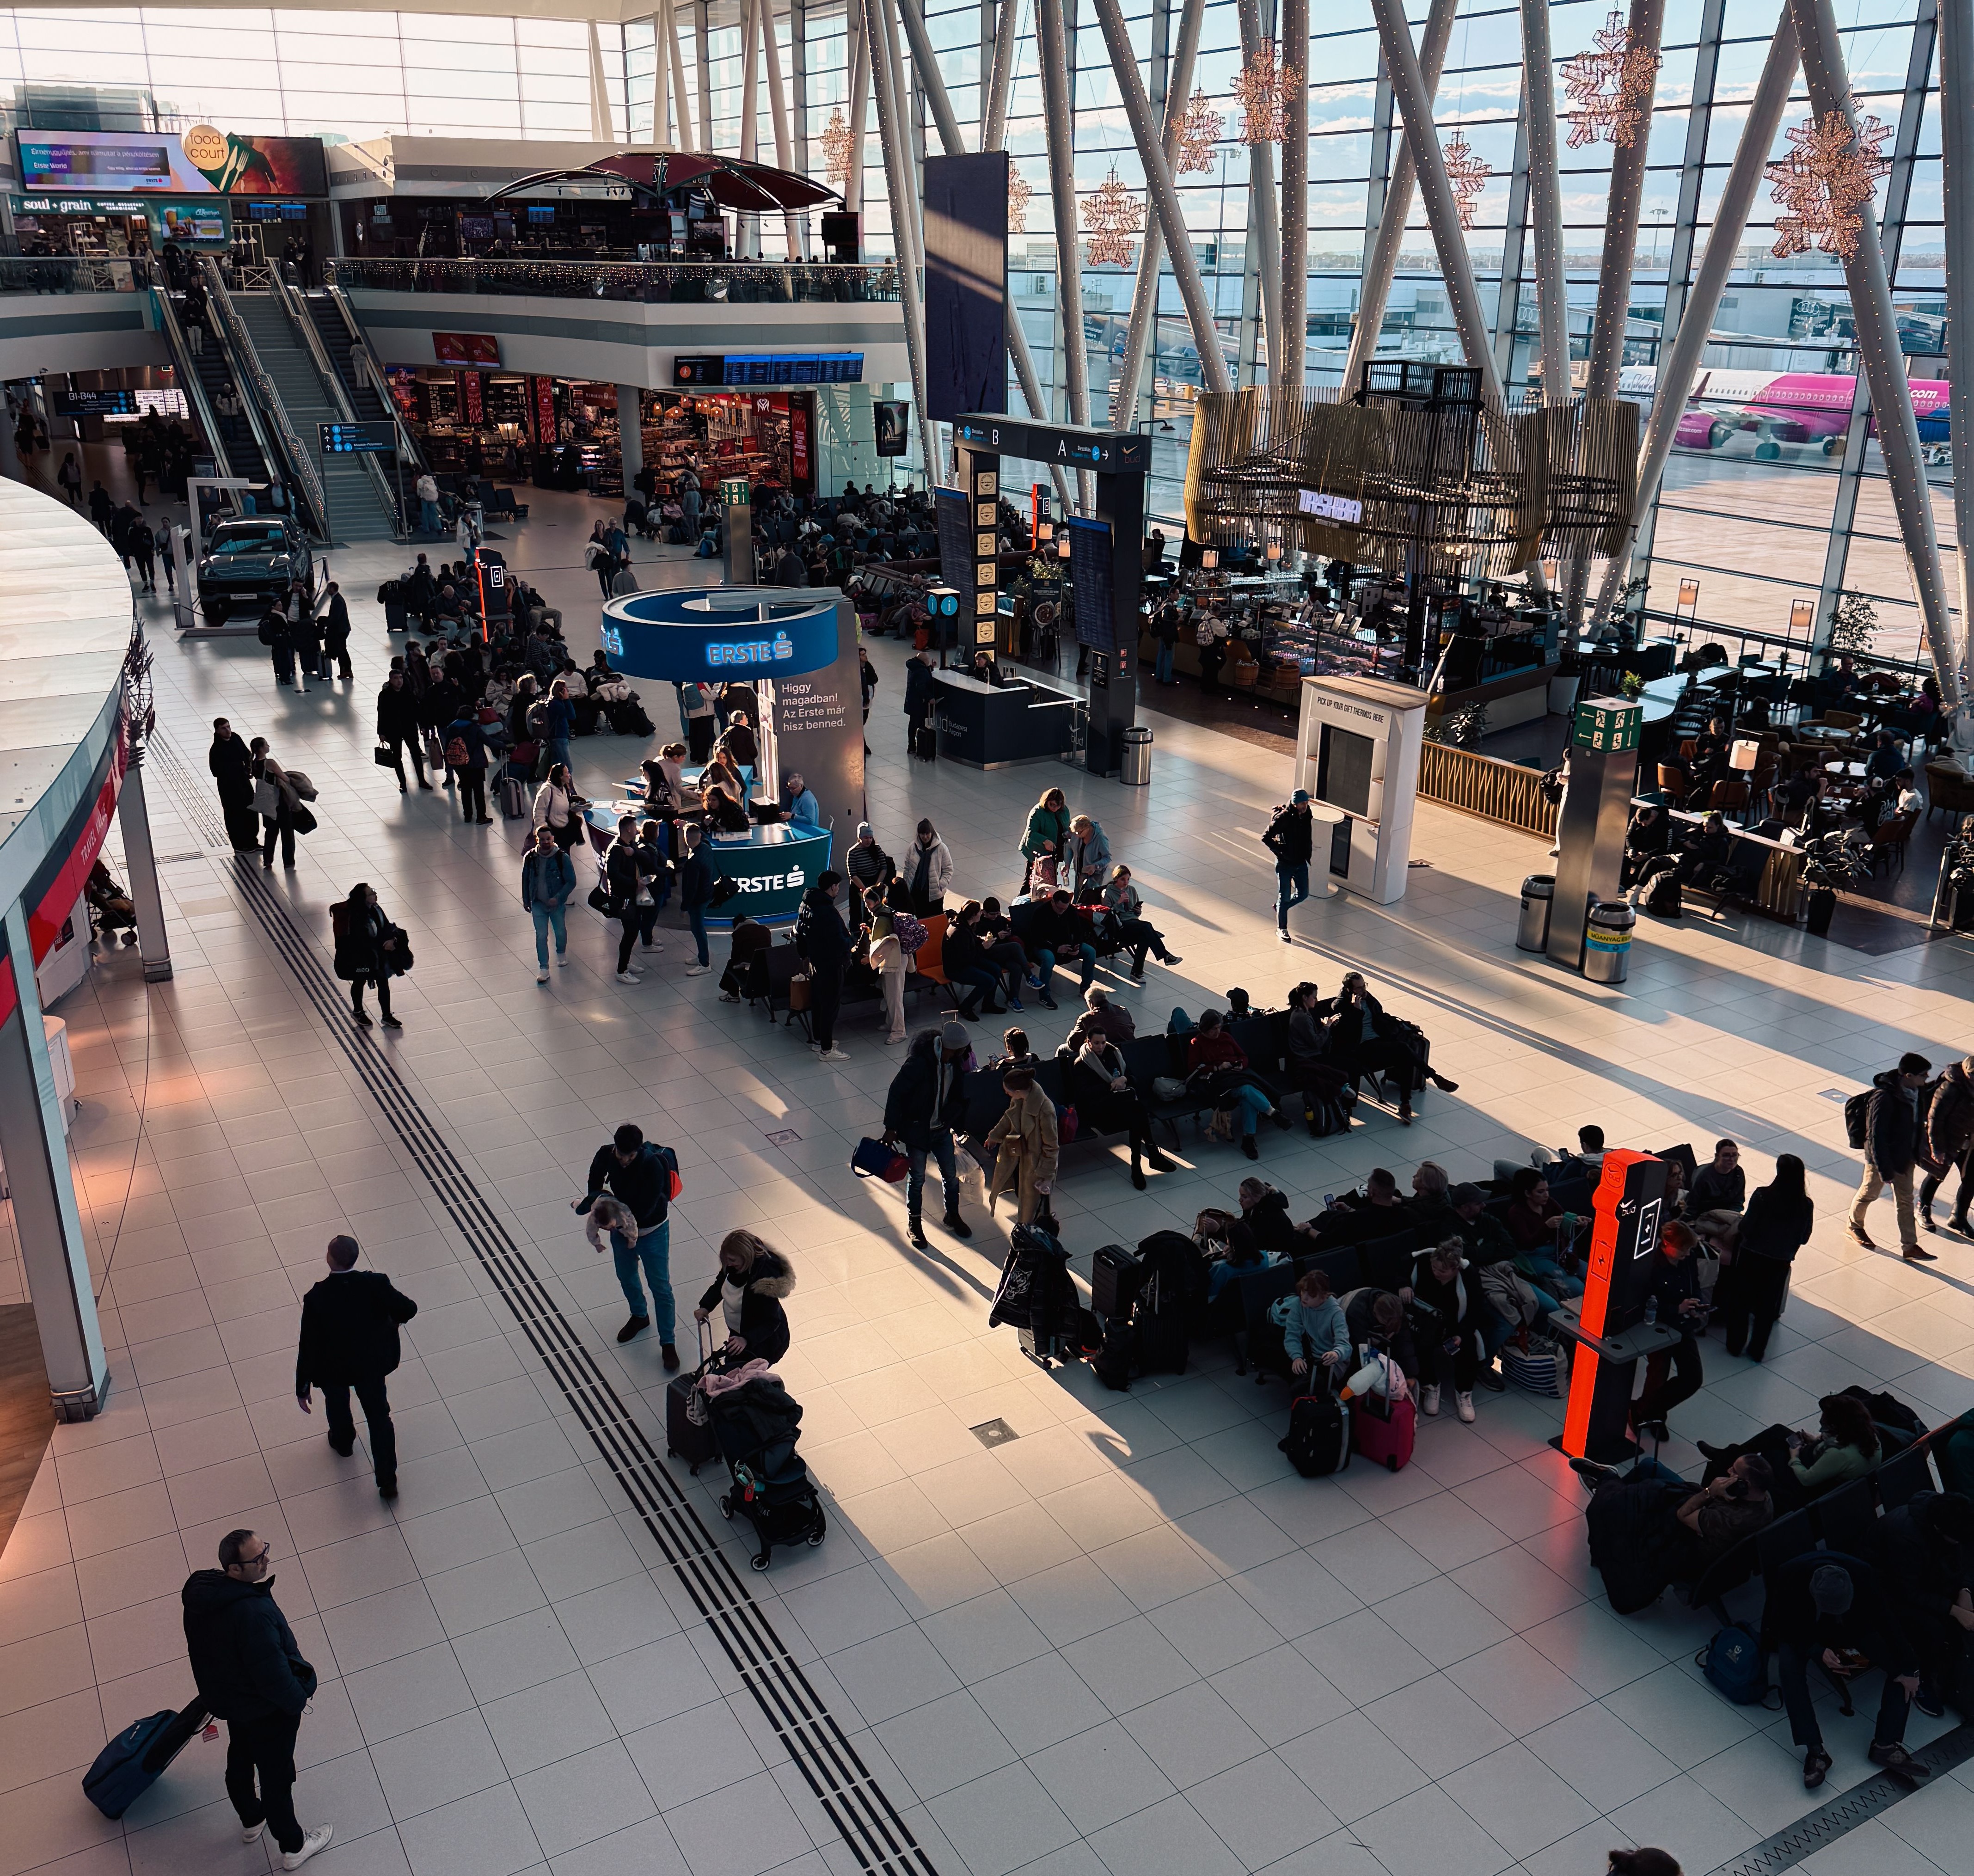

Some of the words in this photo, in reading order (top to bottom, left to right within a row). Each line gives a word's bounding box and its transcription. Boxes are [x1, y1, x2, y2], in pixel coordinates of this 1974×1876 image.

[190, 133, 221, 145] food
[190, 147, 225, 159] court
[24, 198, 50, 210] soul
[60, 200, 92, 213] grain
[993, 429, 999, 445] B
[1058, 440, 1067, 457] A
[1124, 455, 1140, 464] bud
[1298, 489, 1362, 524] TASHBA
[709, 643, 772, 664] ERSTE
[782, 683, 811, 694] Higgy
[782, 693, 838, 707] magadban!
[783, 710, 796, 719] Az
[798, 708, 824, 717] Erste
[827, 705, 846, 715] már
[1317, 696, 1326, 705] PICK
[1333, 701, 1343, 711] YOUR
[1344, 705, 1353, 713] GIFT
[1353, 707, 1372, 719] THERMOS
[1373, 713, 1385, 723] HERE
[783, 722, 803, 731] hisz
[806, 717, 846, 730] benned.
[81, 828, 97, 865] TRAVEL
[730, 874, 784, 893] RSTE
[1608, 1173, 1620, 1183] bud
[1622, 1205, 1636, 1216] bud
